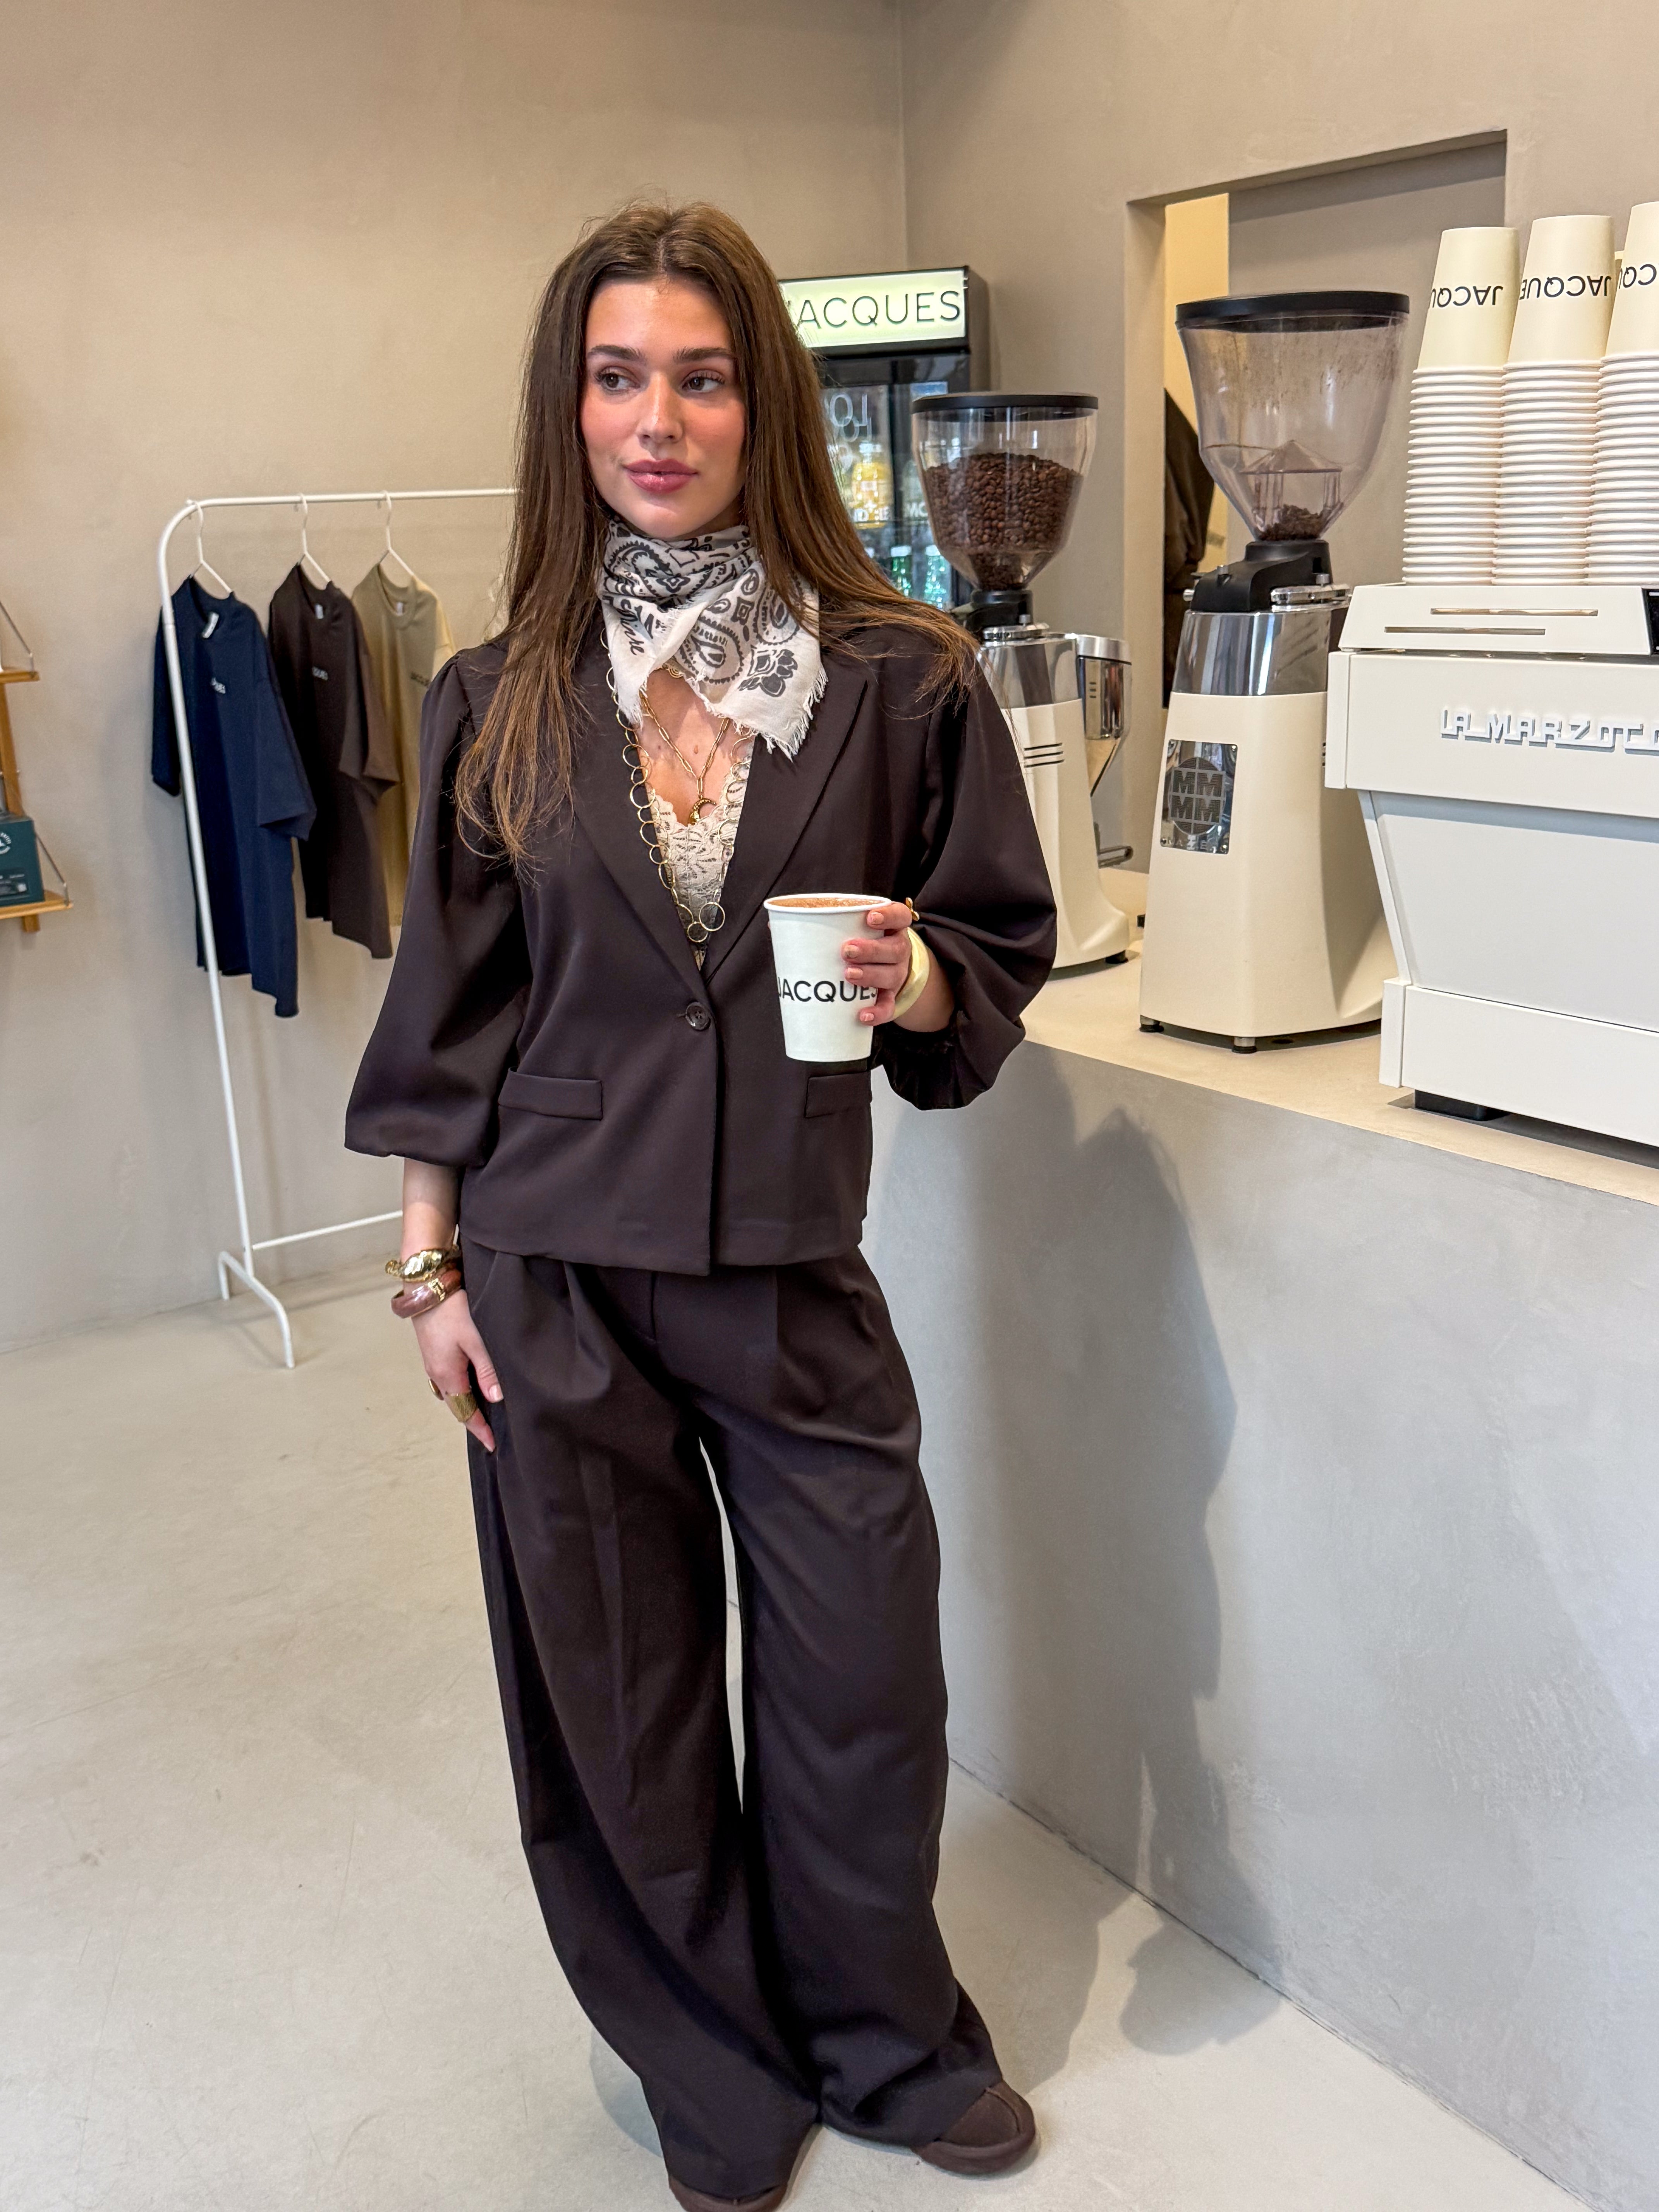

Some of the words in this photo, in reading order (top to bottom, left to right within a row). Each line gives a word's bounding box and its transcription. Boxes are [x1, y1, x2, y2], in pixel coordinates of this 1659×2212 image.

[1519, 275, 1611, 300] JACQUE
[788, 290, 960, 329] ACQUES
[1486, 713, 1659, 757] MARZOC
